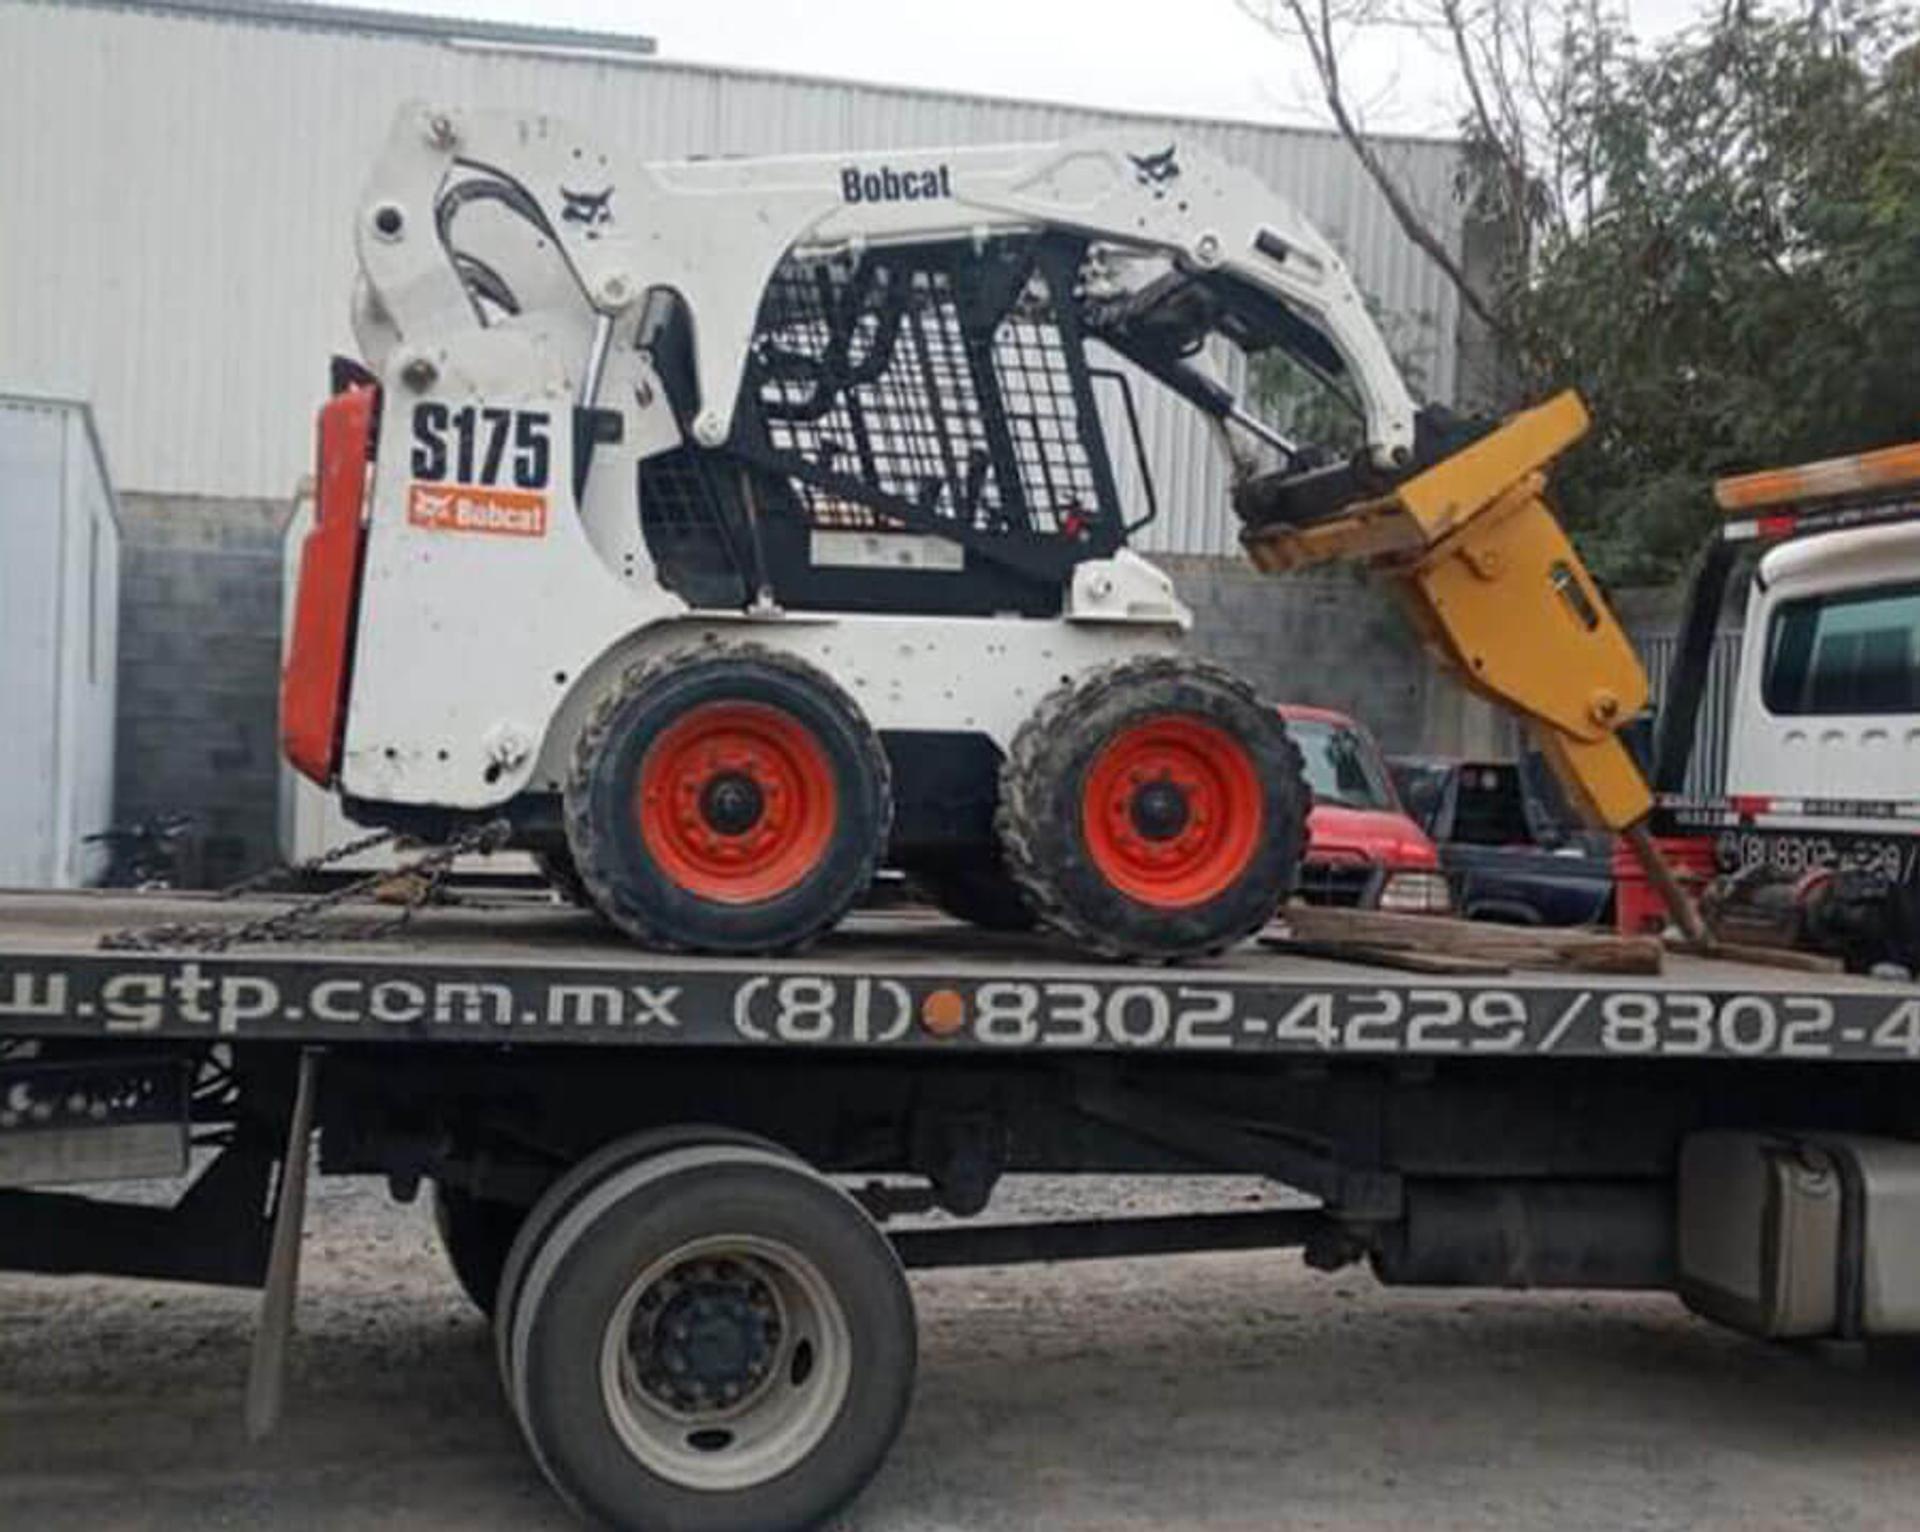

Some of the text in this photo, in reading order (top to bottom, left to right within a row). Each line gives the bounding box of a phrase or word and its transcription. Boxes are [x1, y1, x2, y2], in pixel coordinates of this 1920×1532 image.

[841, 163, 951, 204] Bobcat
[411, 402, 550, 489] S175
[734, 977, 910, 1041] (81)
